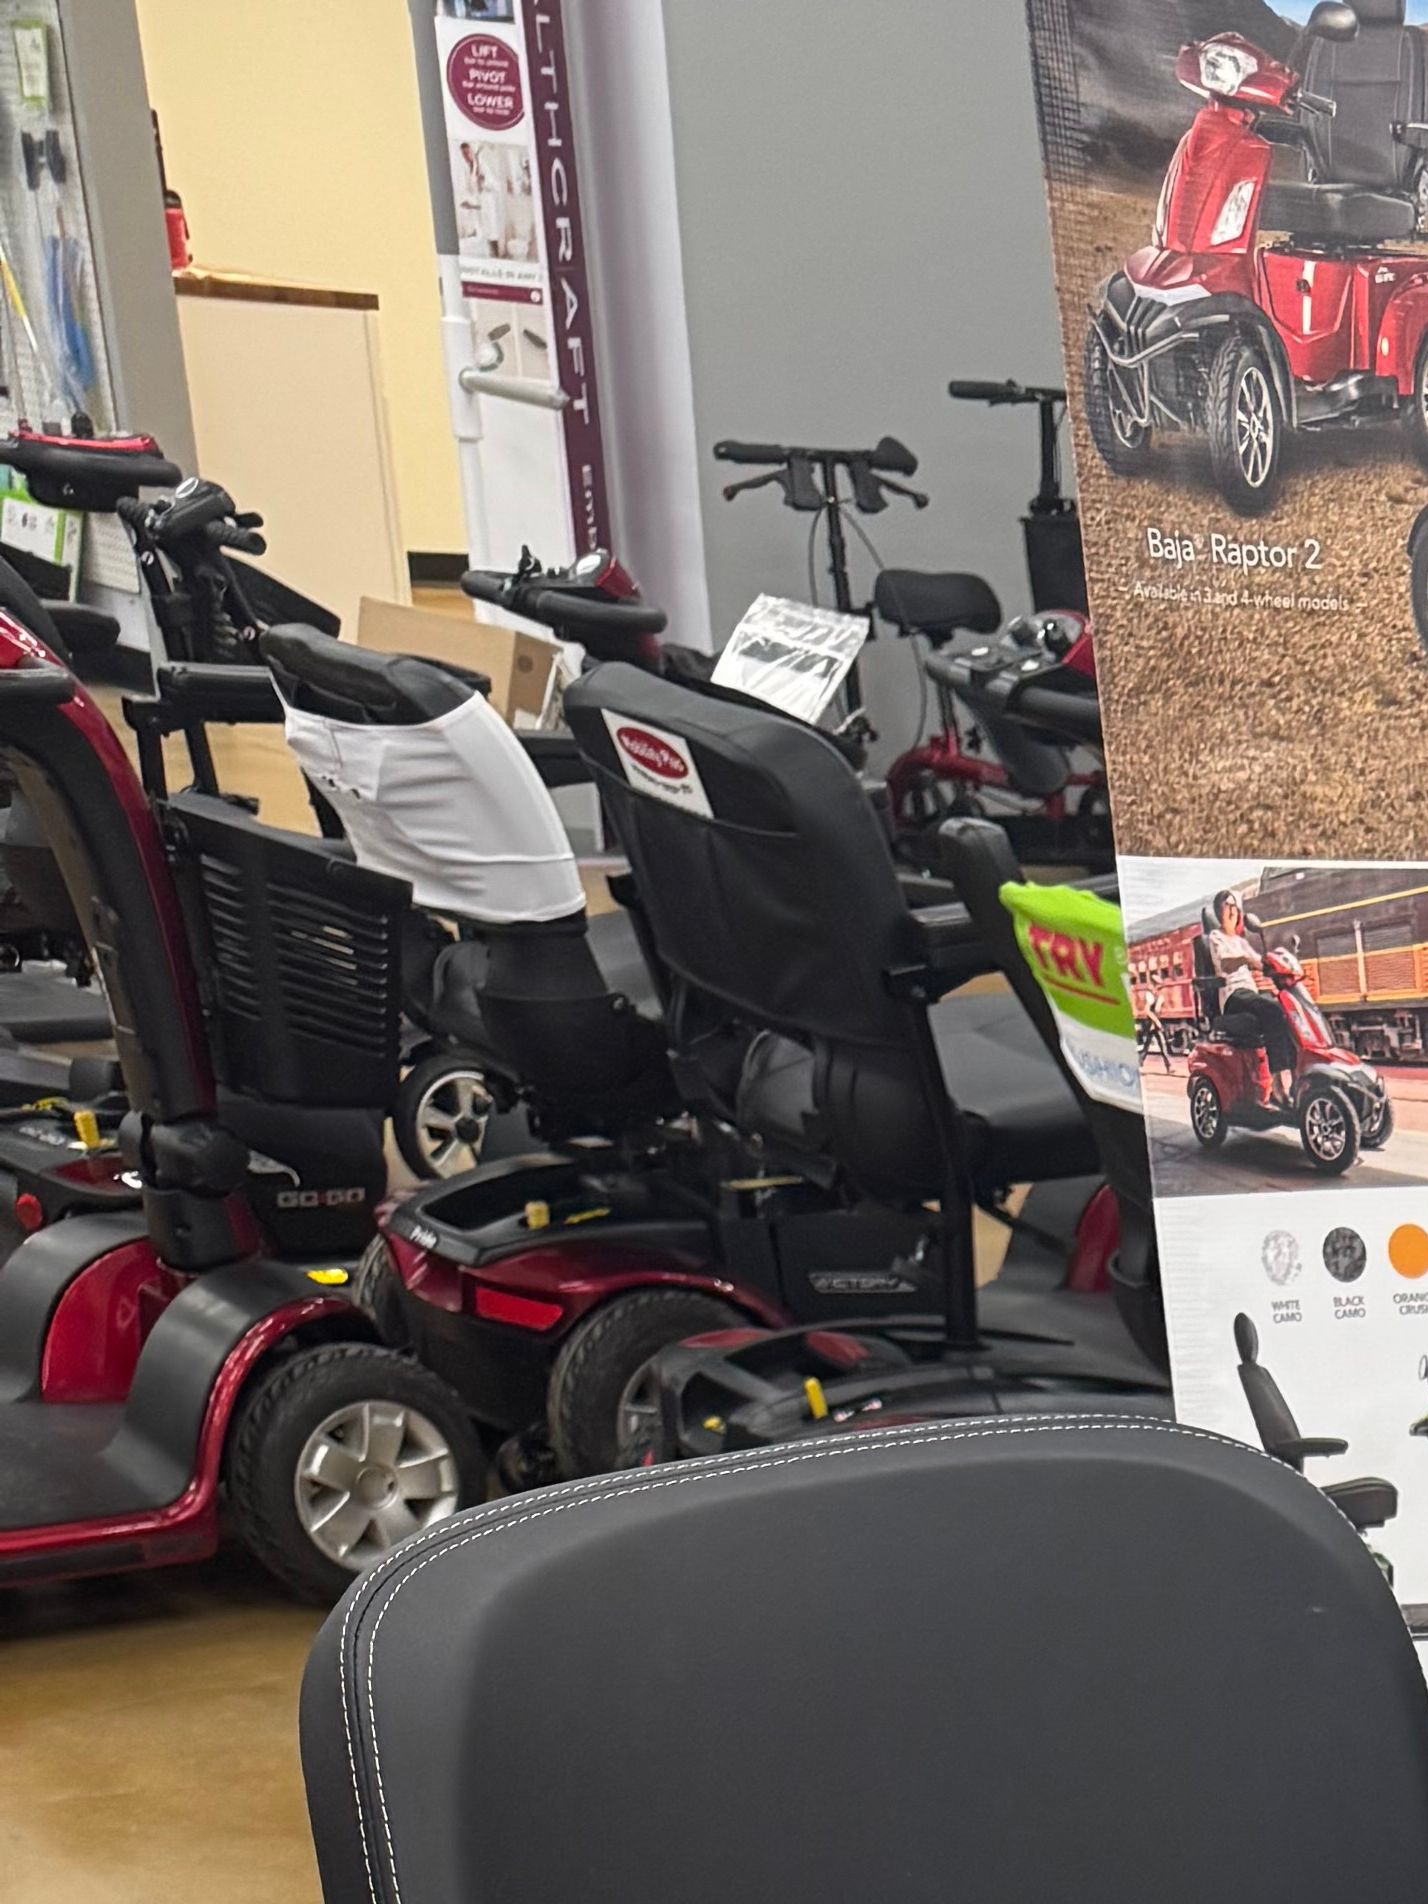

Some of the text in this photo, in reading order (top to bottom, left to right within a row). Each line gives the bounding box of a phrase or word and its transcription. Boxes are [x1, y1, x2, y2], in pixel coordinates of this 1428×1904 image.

[469, 69, 505, 83] PIVOT
[467, 93, 513, 109] LOWER
[534, 0, 589, 424] LTHCRAFT
[1210, 533, 1297, 575] Raptor
[1304, 539, 1321, 569] 2
[1133, 581, 1350, 611] Available in 3 and 4-wheel models
[1029, 925, 1103, 988] TRY
[1271, 1299, 1301, 1312] WHITE
[1333, 1296, 1365, 1308] BLACK
[1273, 1312, 1302, 1324] CAMO
[1335, 1308, 1366, 1320] CAMO
